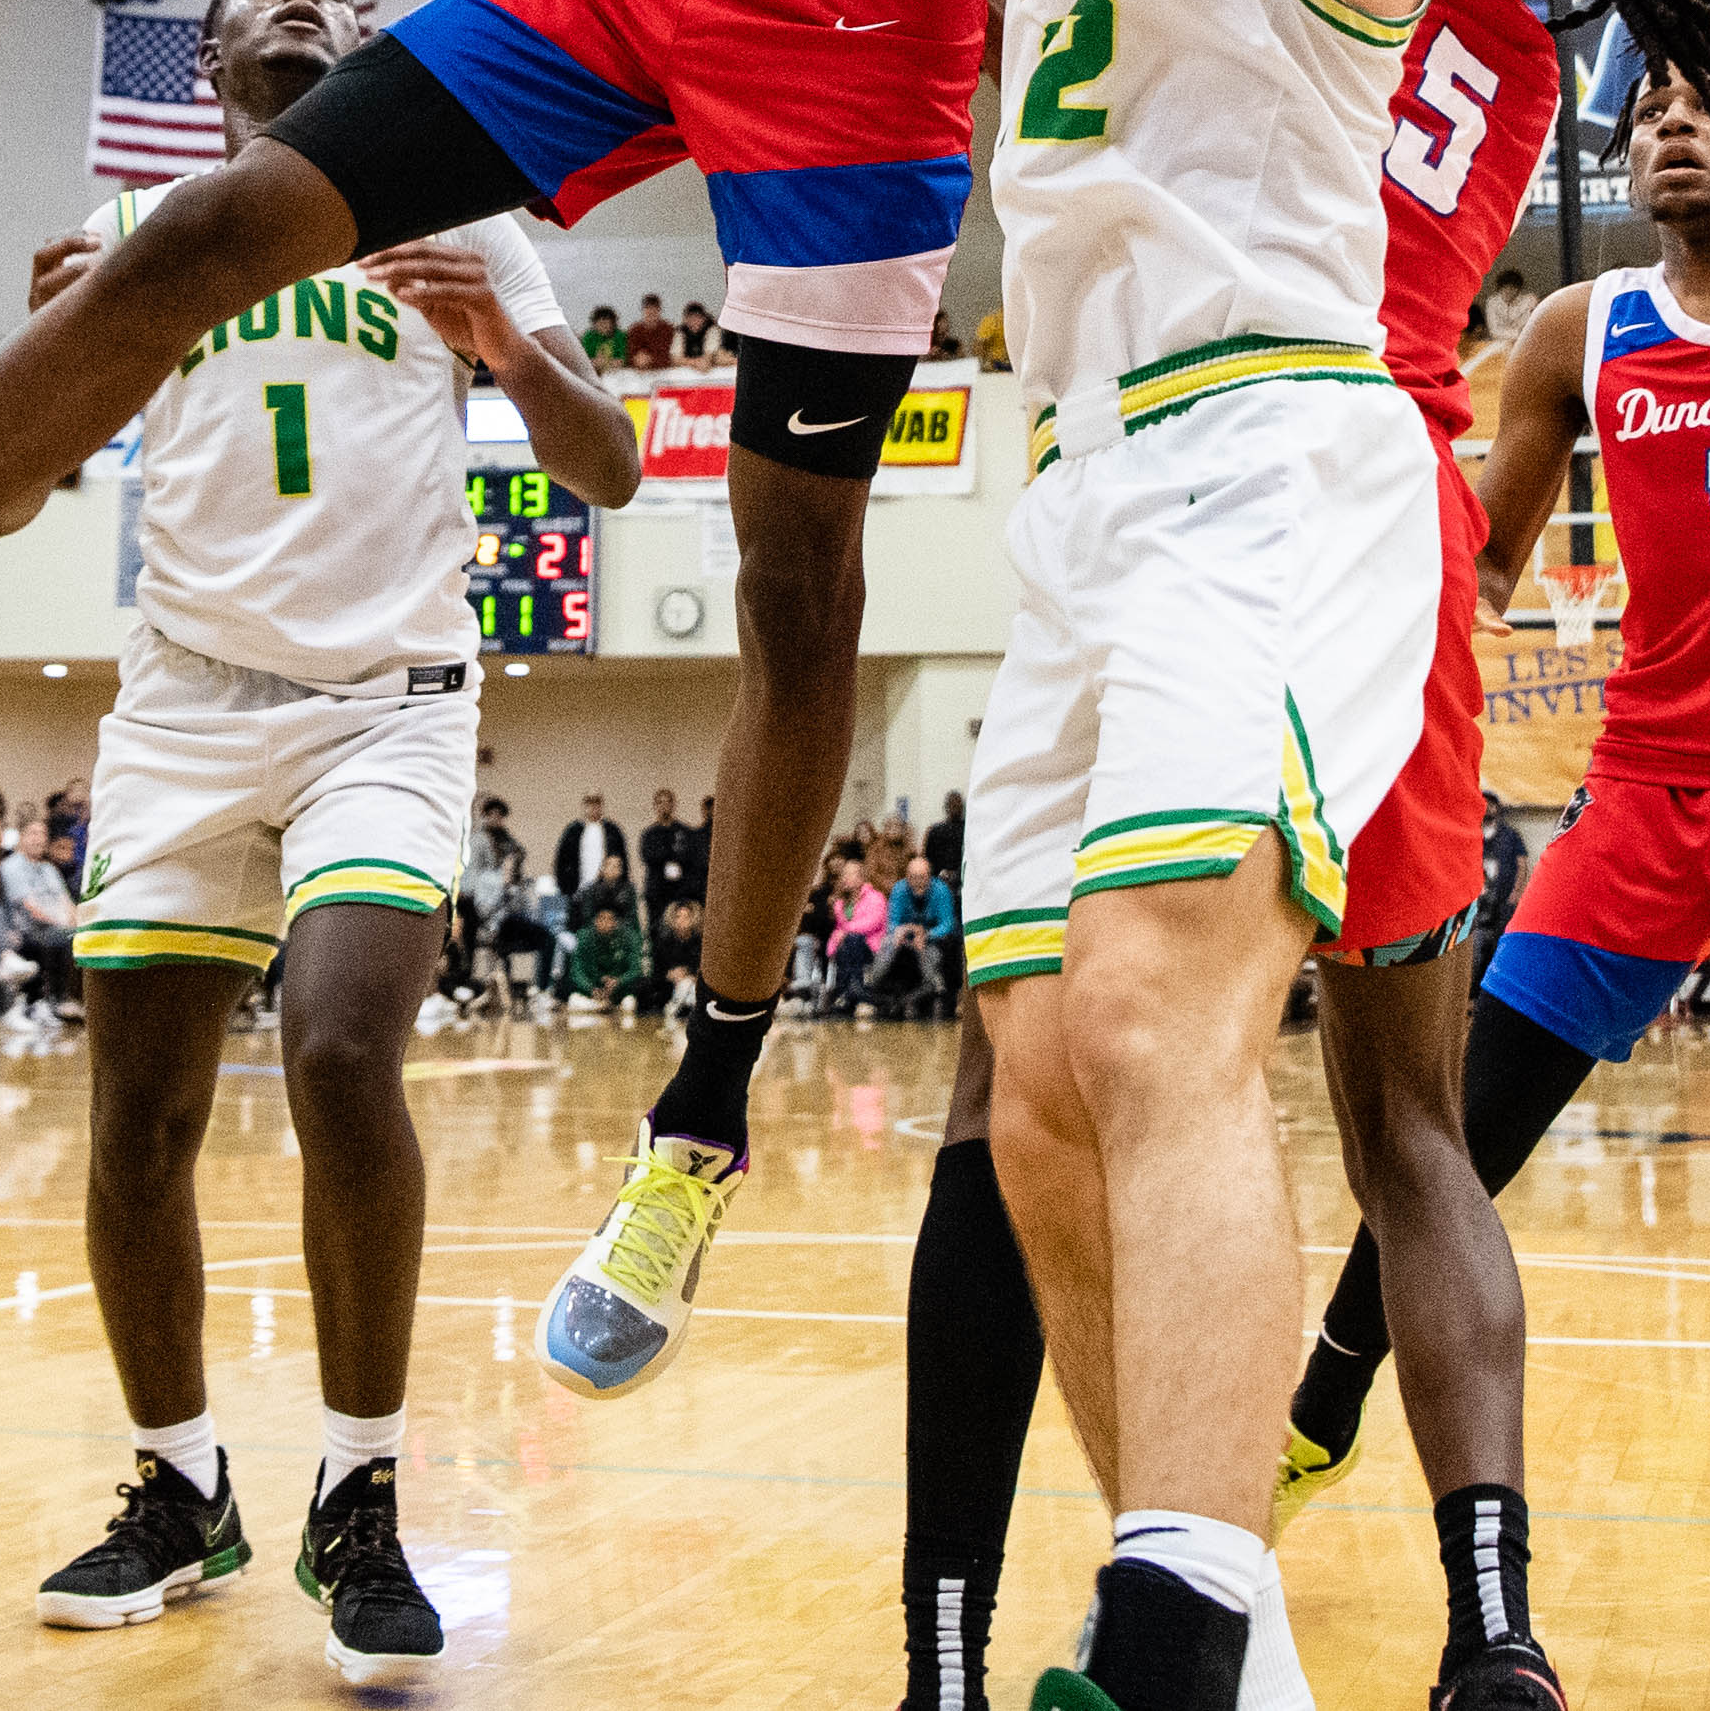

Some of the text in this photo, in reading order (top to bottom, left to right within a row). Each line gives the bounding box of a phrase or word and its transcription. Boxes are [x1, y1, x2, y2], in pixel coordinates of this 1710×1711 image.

[264, 384, 312, 495] 1
[536, 532, 593, 579] 21
[1505, 648, 1587, 683] LES
